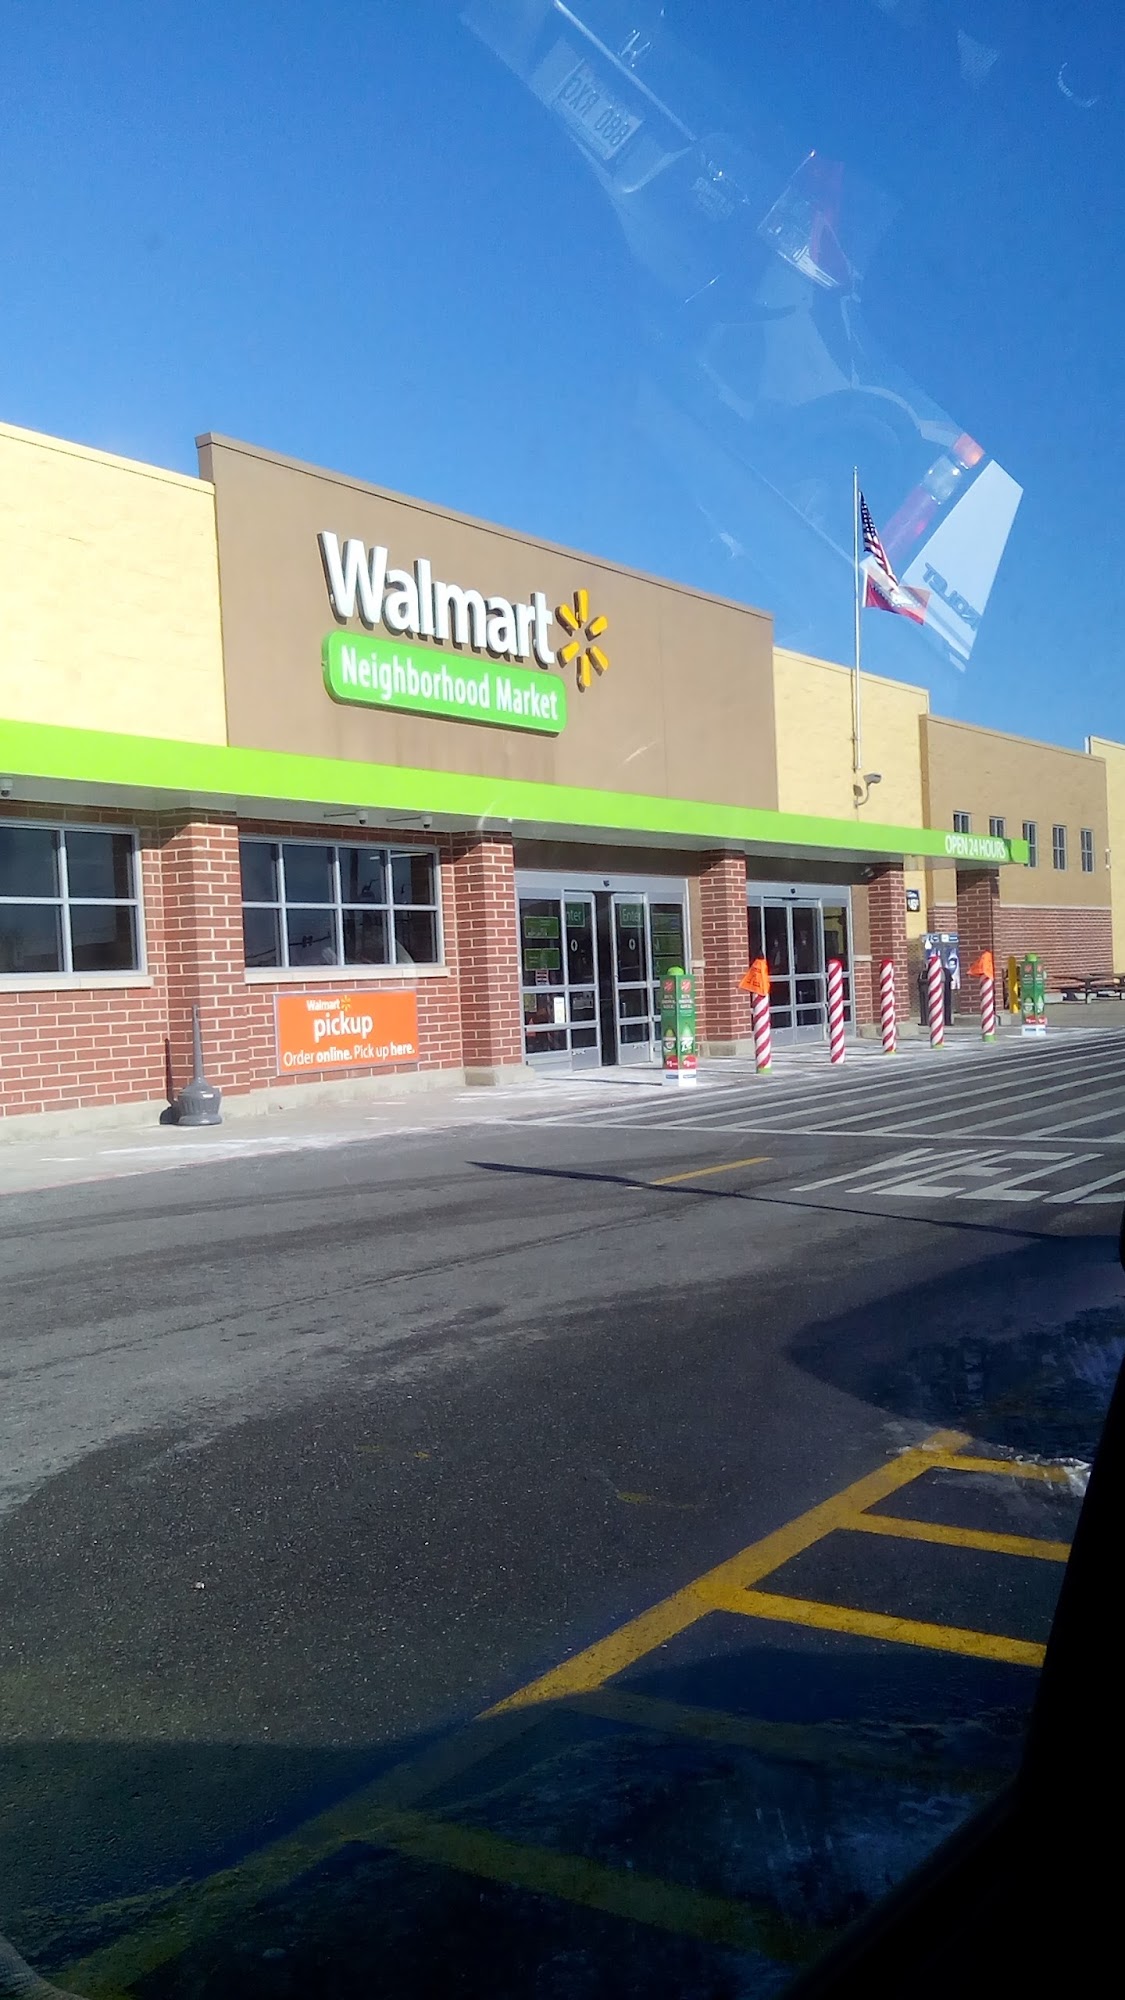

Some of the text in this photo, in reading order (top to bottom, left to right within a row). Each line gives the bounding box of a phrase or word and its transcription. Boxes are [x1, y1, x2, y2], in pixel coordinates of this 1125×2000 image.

[319, 531, 556, 664] Walmart
[341, 645, 559, 720] Neighborhood Market
[945, 834, 1006, 859] OPEN 24 HOURS
[566, 908, 582, 921] nter
[622, 908, 641, 923] Enter
[306, 999, 341, 1011] Walmart
[314, 1011, 374, 1043] pickup
[284, 1042, 416, 1067] Order online. Pick up here.
